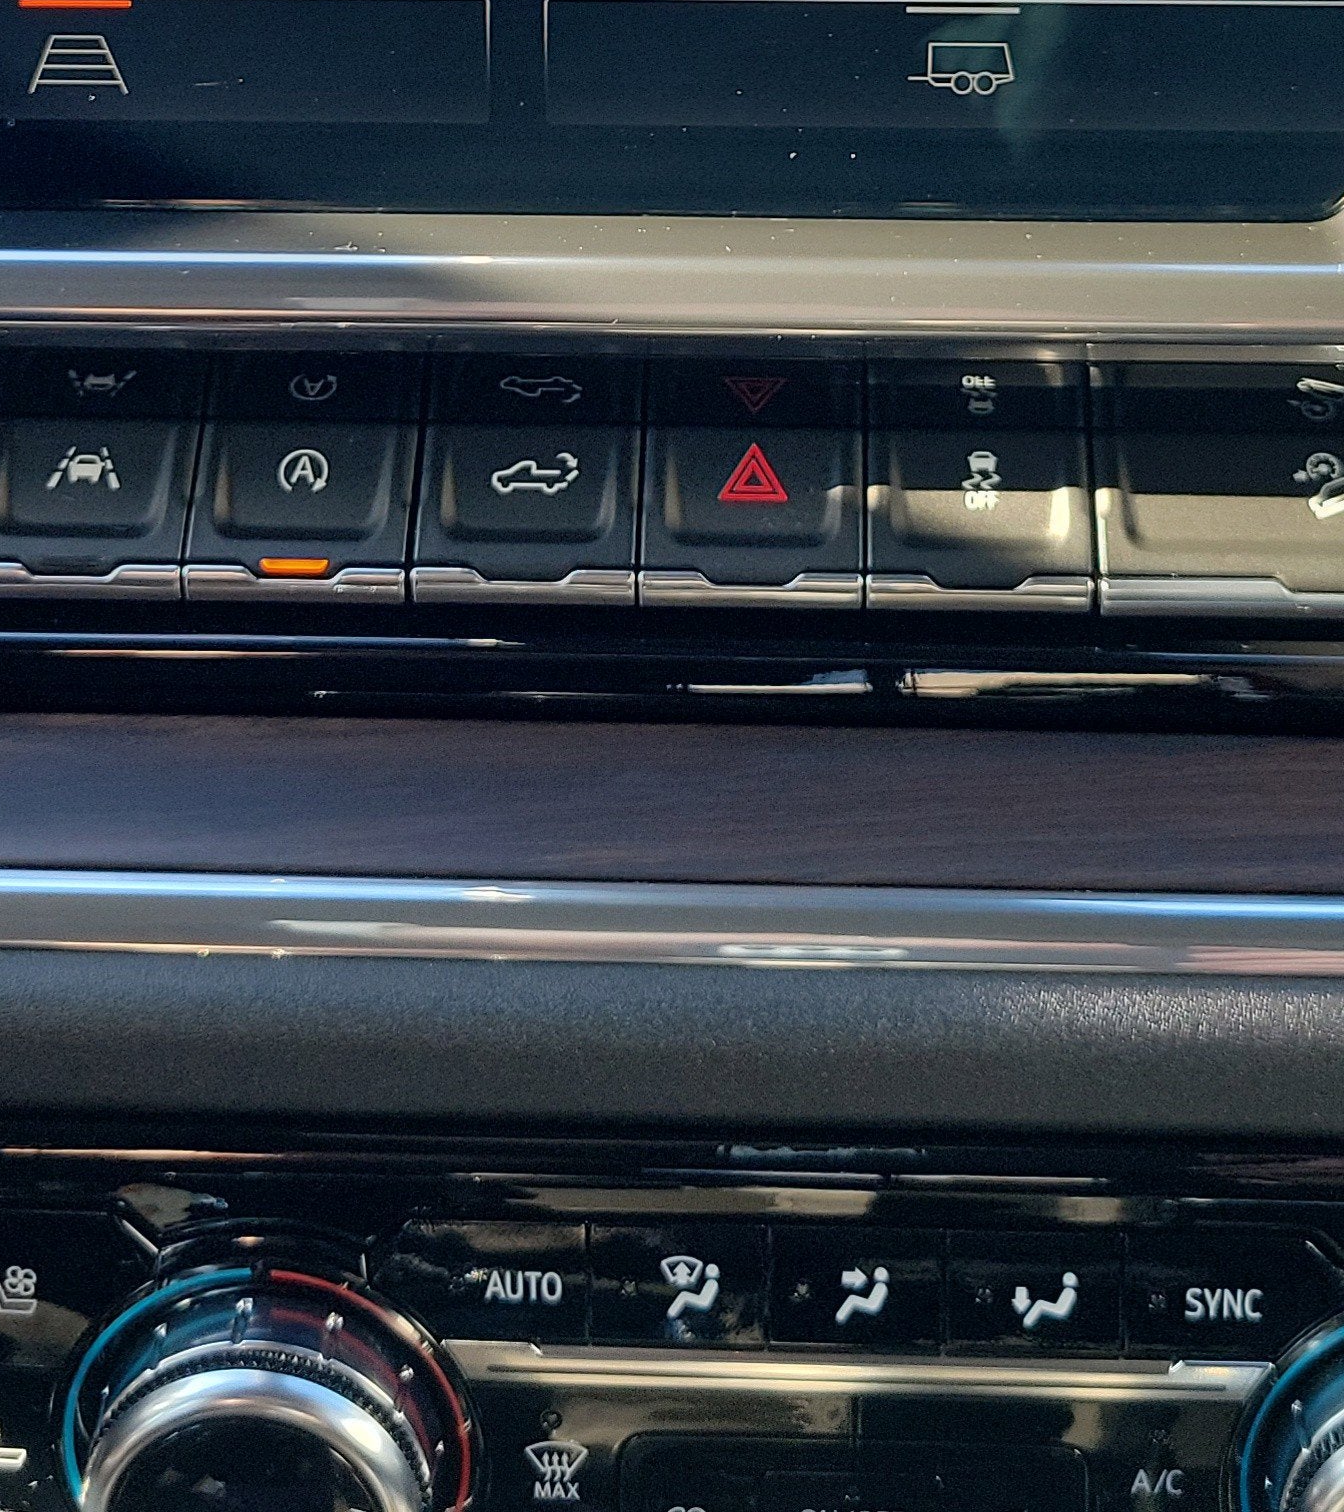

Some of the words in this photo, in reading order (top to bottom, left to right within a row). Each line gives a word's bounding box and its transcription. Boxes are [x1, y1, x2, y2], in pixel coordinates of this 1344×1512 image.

[963, 490, 1001, 511] OFF
[484, 1269, 563, 1304] AUTO
[1184, 1287, 1264, 1322] SYNC
[533, 1480, 581, 1501] MAX
[1130, 1468, 1185, 1496] A/C
